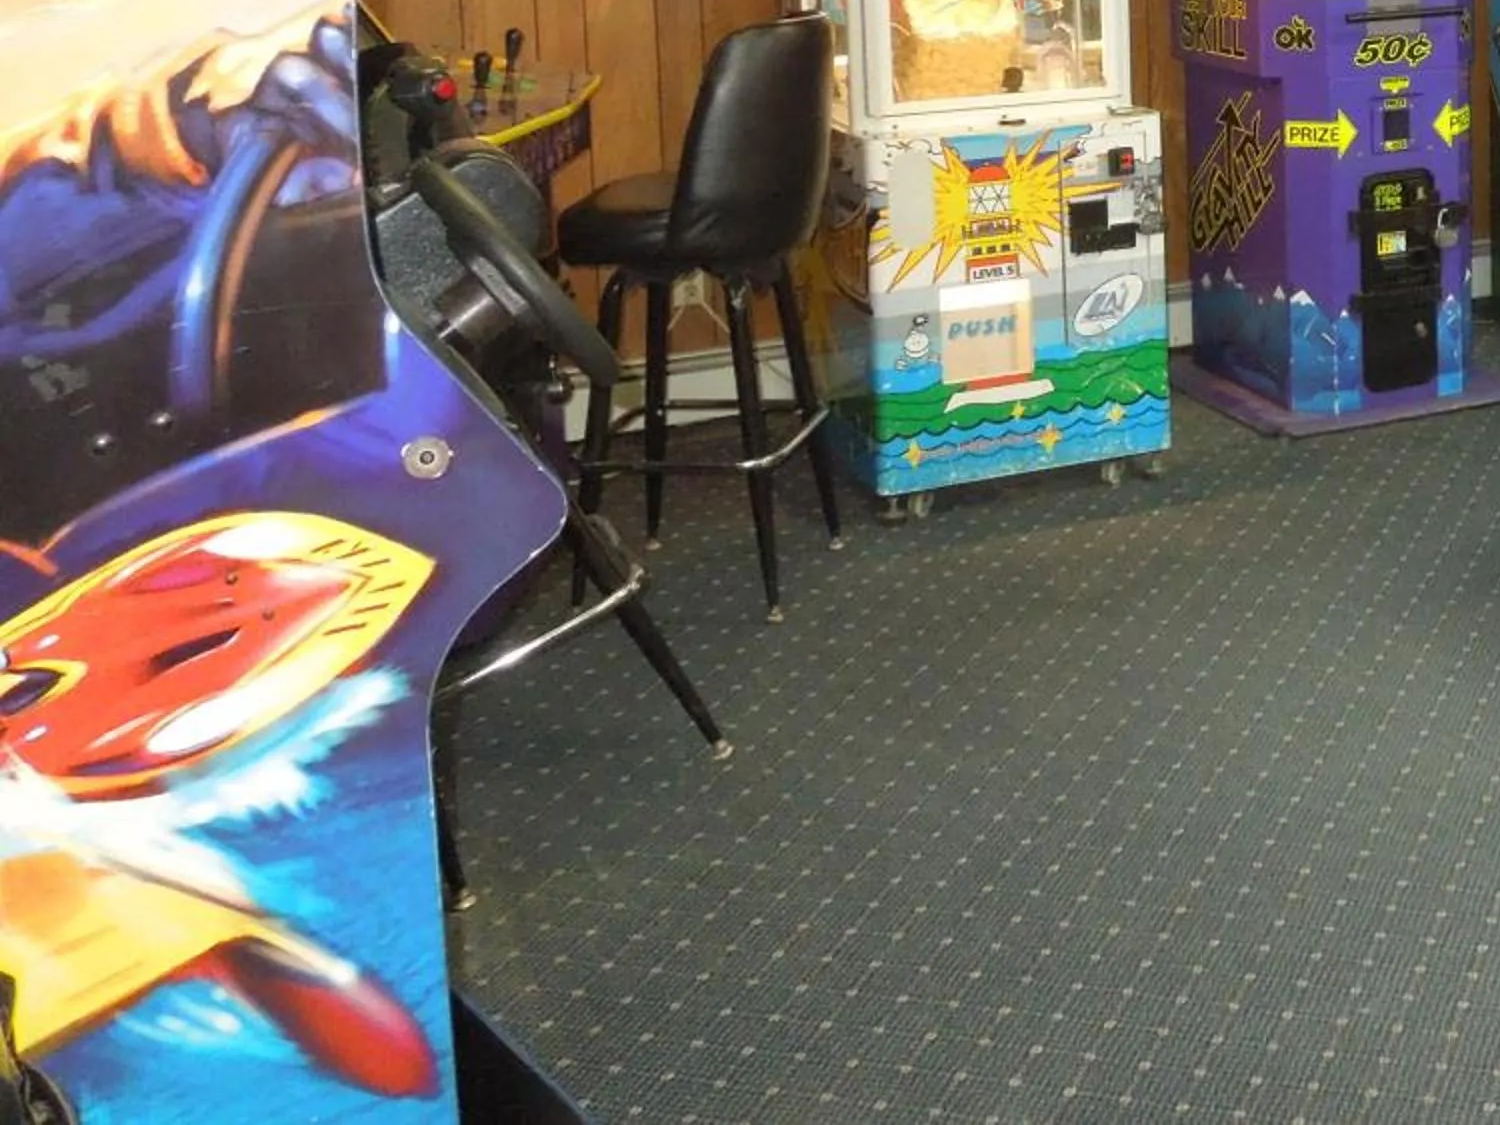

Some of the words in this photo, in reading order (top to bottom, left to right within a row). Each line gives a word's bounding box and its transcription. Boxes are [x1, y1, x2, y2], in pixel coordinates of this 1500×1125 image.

[1179, 12, 1248, 60] SKILL
[1354, 33, 1432, 67] 50¢
[1289, 126, 1340, 144] PRIZE
[973, 266, 1005, 280] LEVEL
[947, 314, 1018, 340] PUSH
